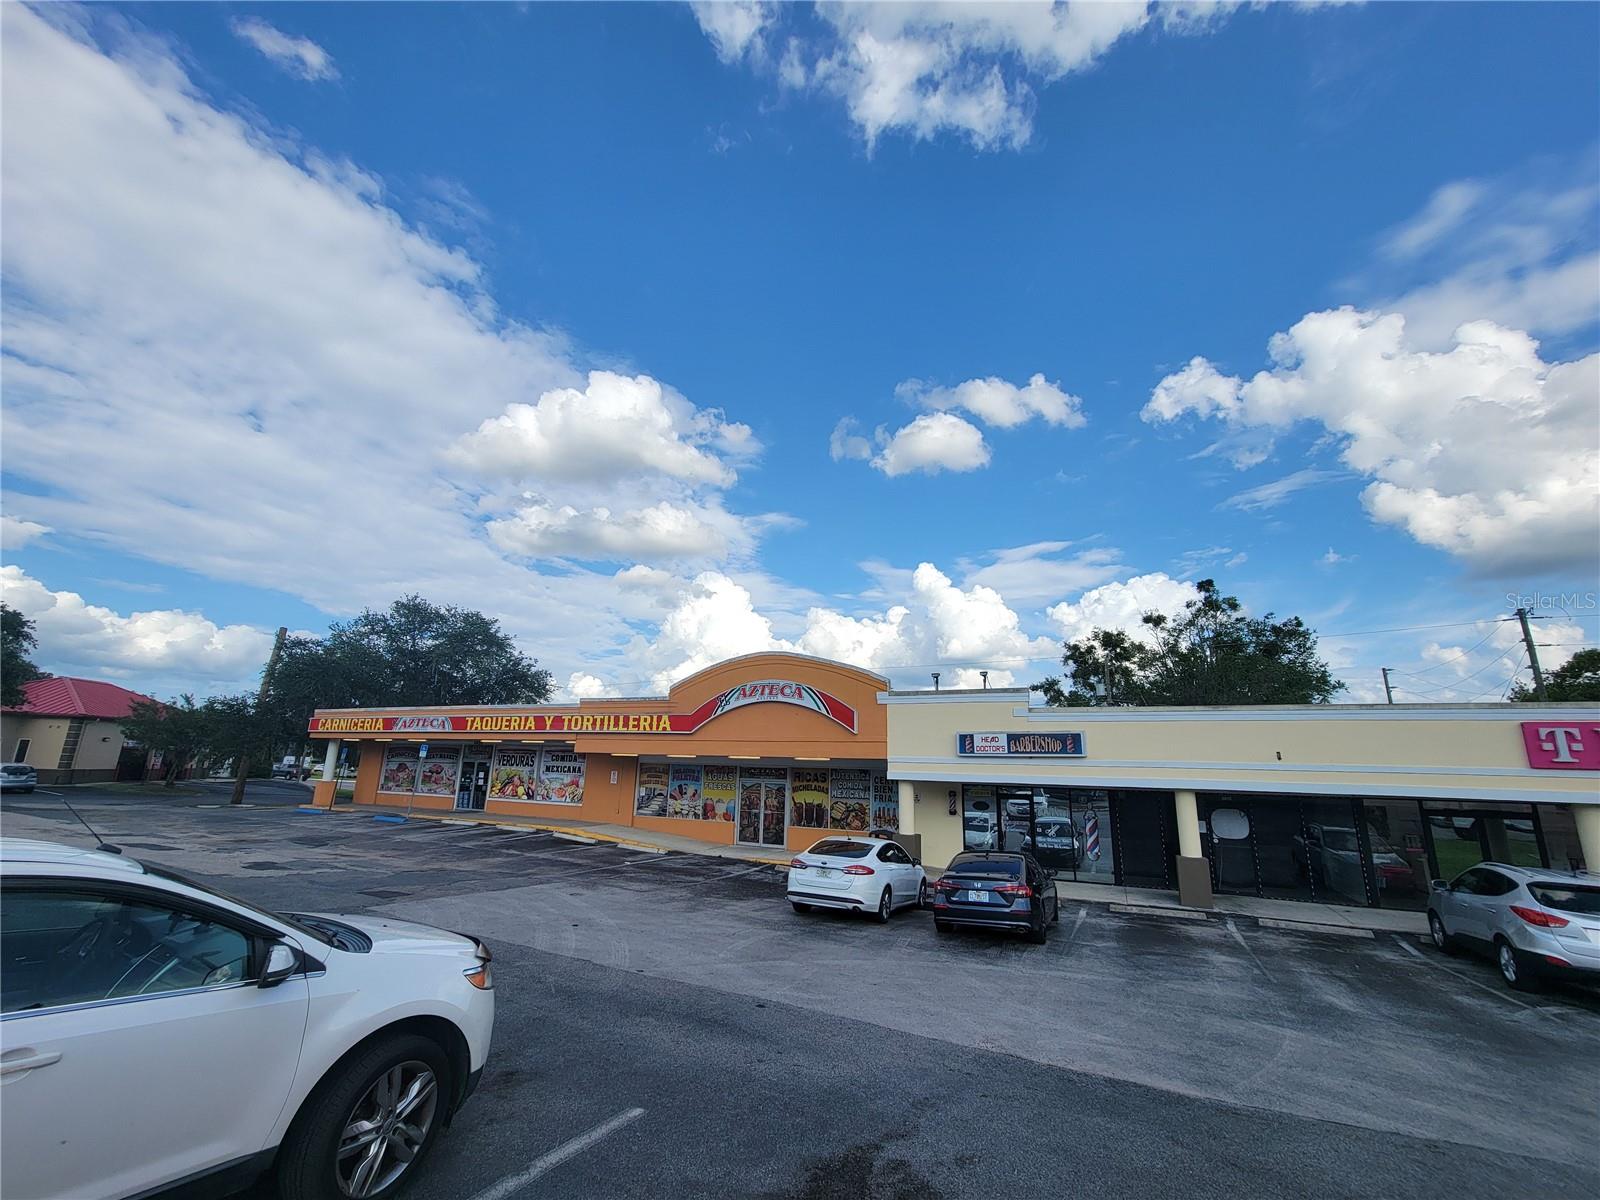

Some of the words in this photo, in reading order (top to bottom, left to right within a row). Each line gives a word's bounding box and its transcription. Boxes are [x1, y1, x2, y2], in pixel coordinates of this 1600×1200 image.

[735, 684, 804, 701] AZTECA
[318, 717, 384, 731] CARNICERIA
[399, 718, 447, 731] AZTECA
[465, 716, 537, 731] TAQUERIA
[545, 716, 554, 730] Y
[562, 715, 671, 732] TORTILLERIA
[1010, 735, 1063, 753] BARBERSHOP
[497, 752, 536, 768] VERDURAS
[551, 754, 578, 763] COMIDA
[544, 764, 582, 775] MEXICANA
[707, 773, 734, 782] AGUAS
[793, 771, 828, 783] RICAS
[704, 782, 736, 790] FRESCAS
[838, 781, 864, 790] COMIDA
[831, 790, 870, 799] MEXICANA
